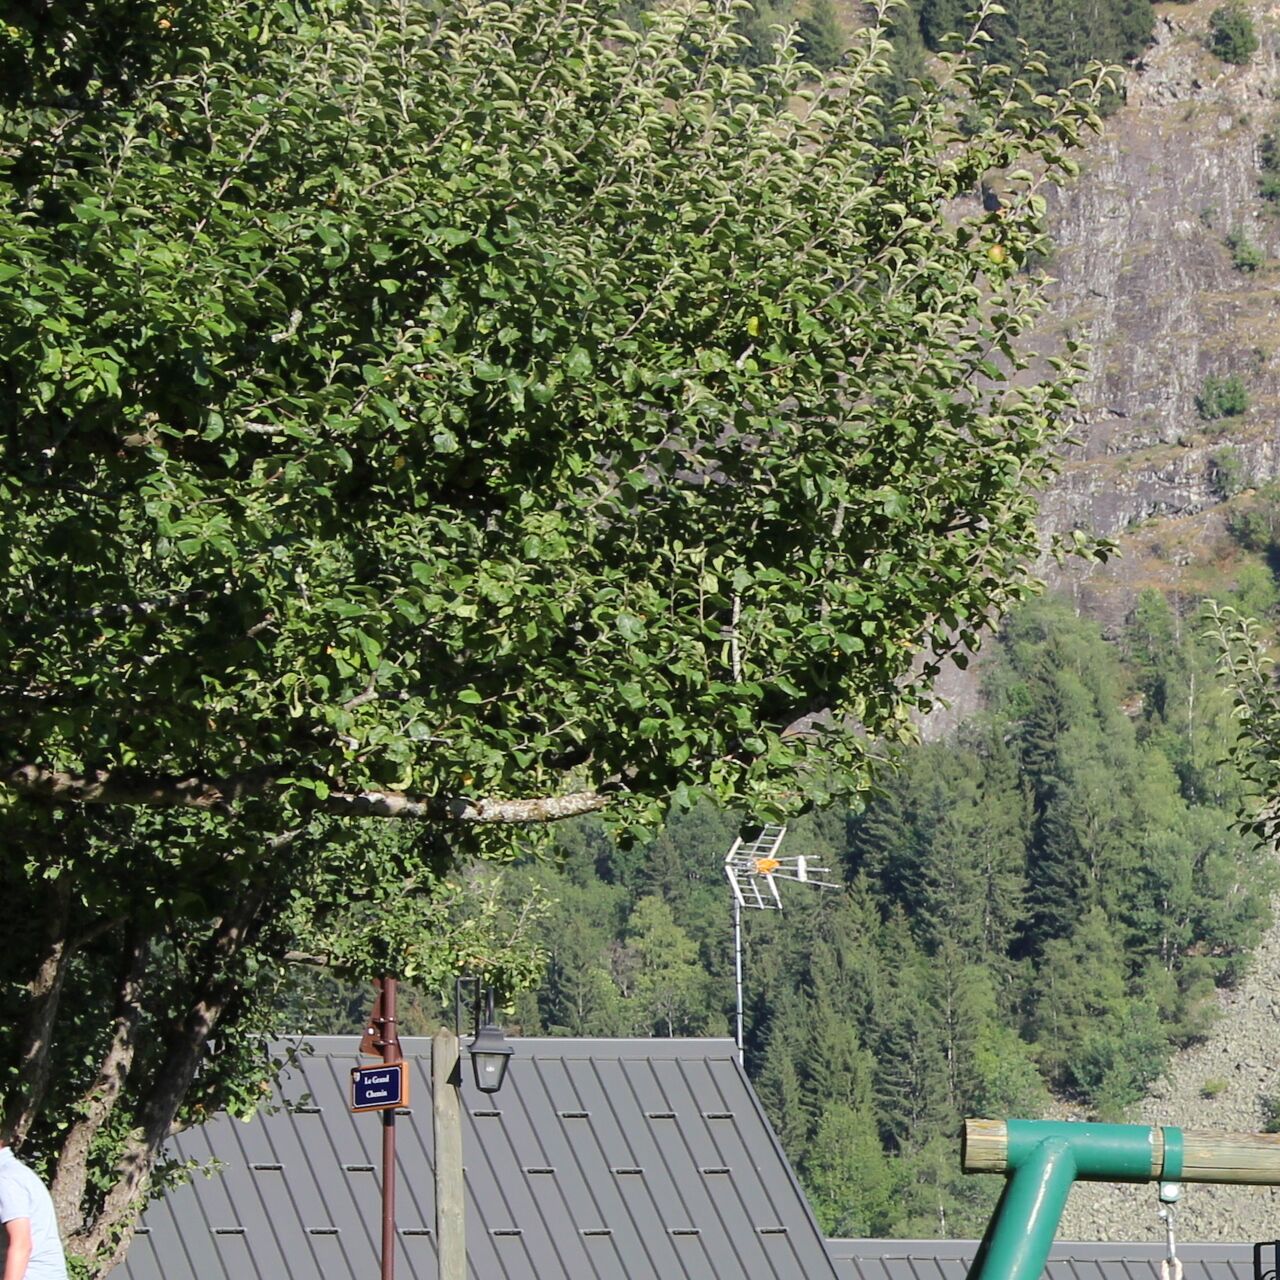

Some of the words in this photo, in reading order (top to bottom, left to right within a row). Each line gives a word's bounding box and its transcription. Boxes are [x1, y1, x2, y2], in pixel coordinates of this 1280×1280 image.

[364, 1077, 371, 1085] Le
[372, 1074, 389, 1084] Grand
[366, 1089, 388, 1098] Chemin
